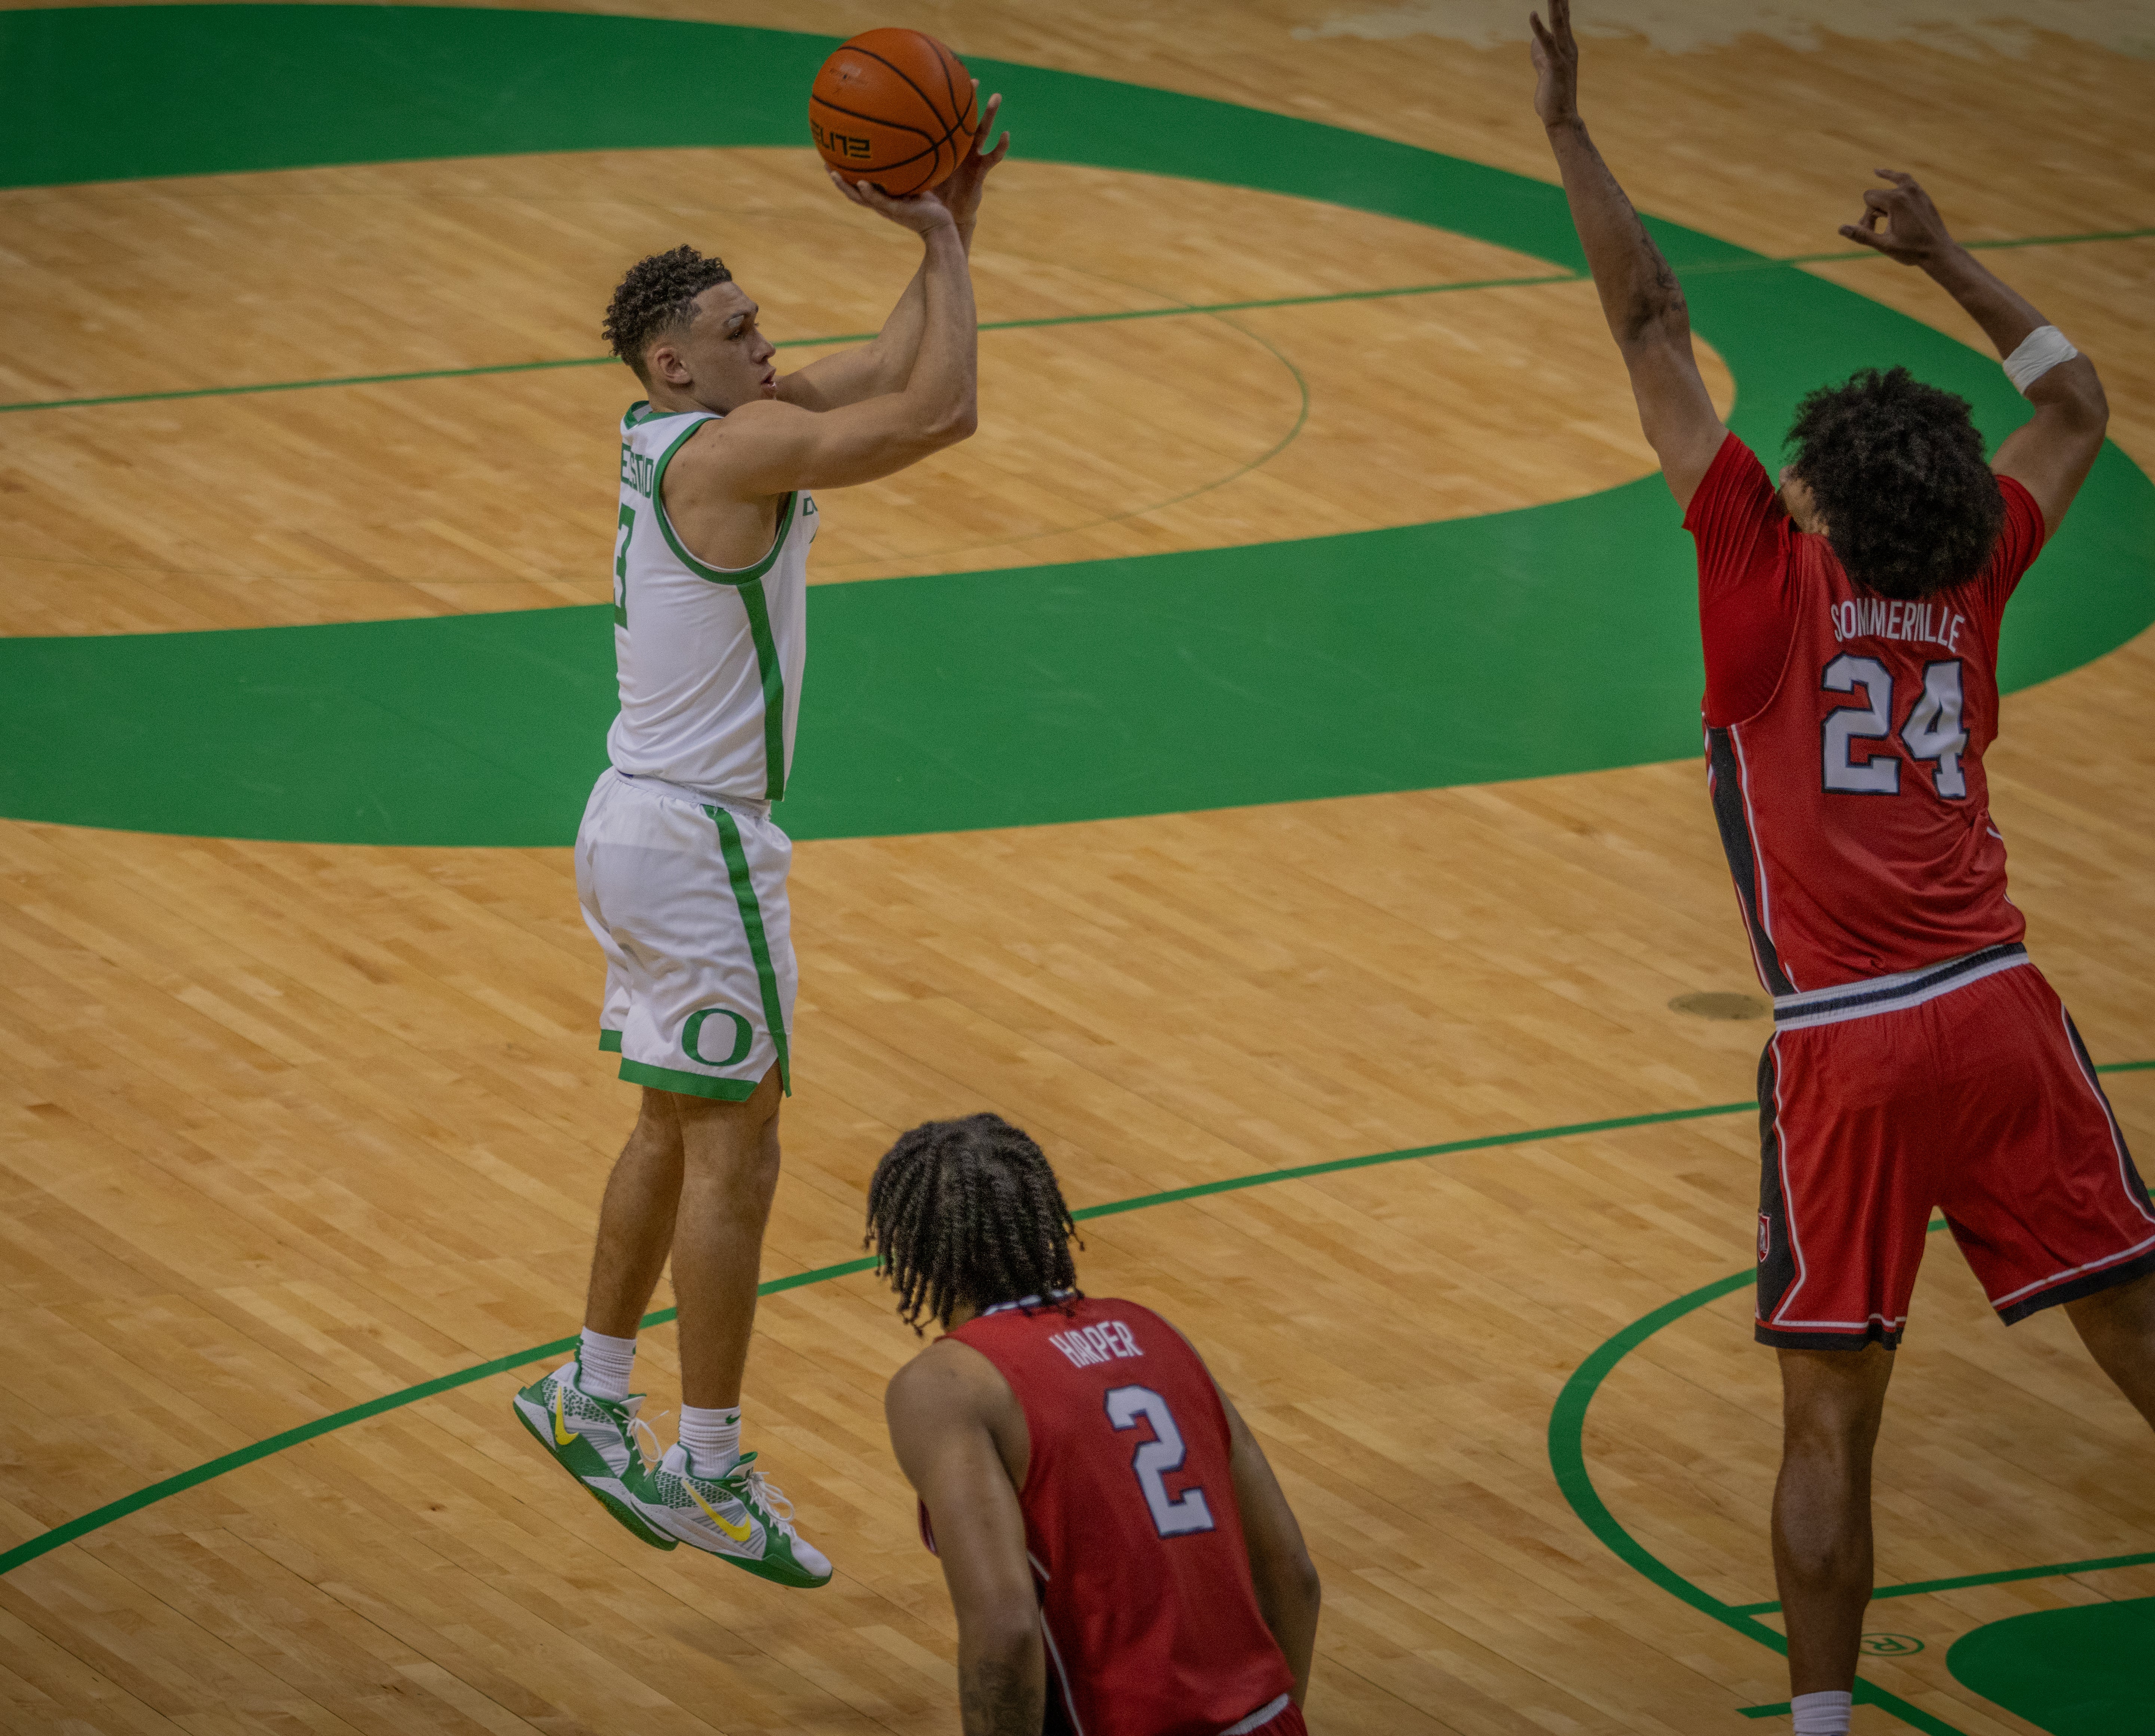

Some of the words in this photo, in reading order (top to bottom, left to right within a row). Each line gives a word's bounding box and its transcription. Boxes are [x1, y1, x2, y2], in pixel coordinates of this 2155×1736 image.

[1821, 651, 1970, 799] 24
[682, 1009, 752, 1066] O
[1048, 1321, 1143, 1368] HARPER
[1104, 1385, 1215, 1538] 2
